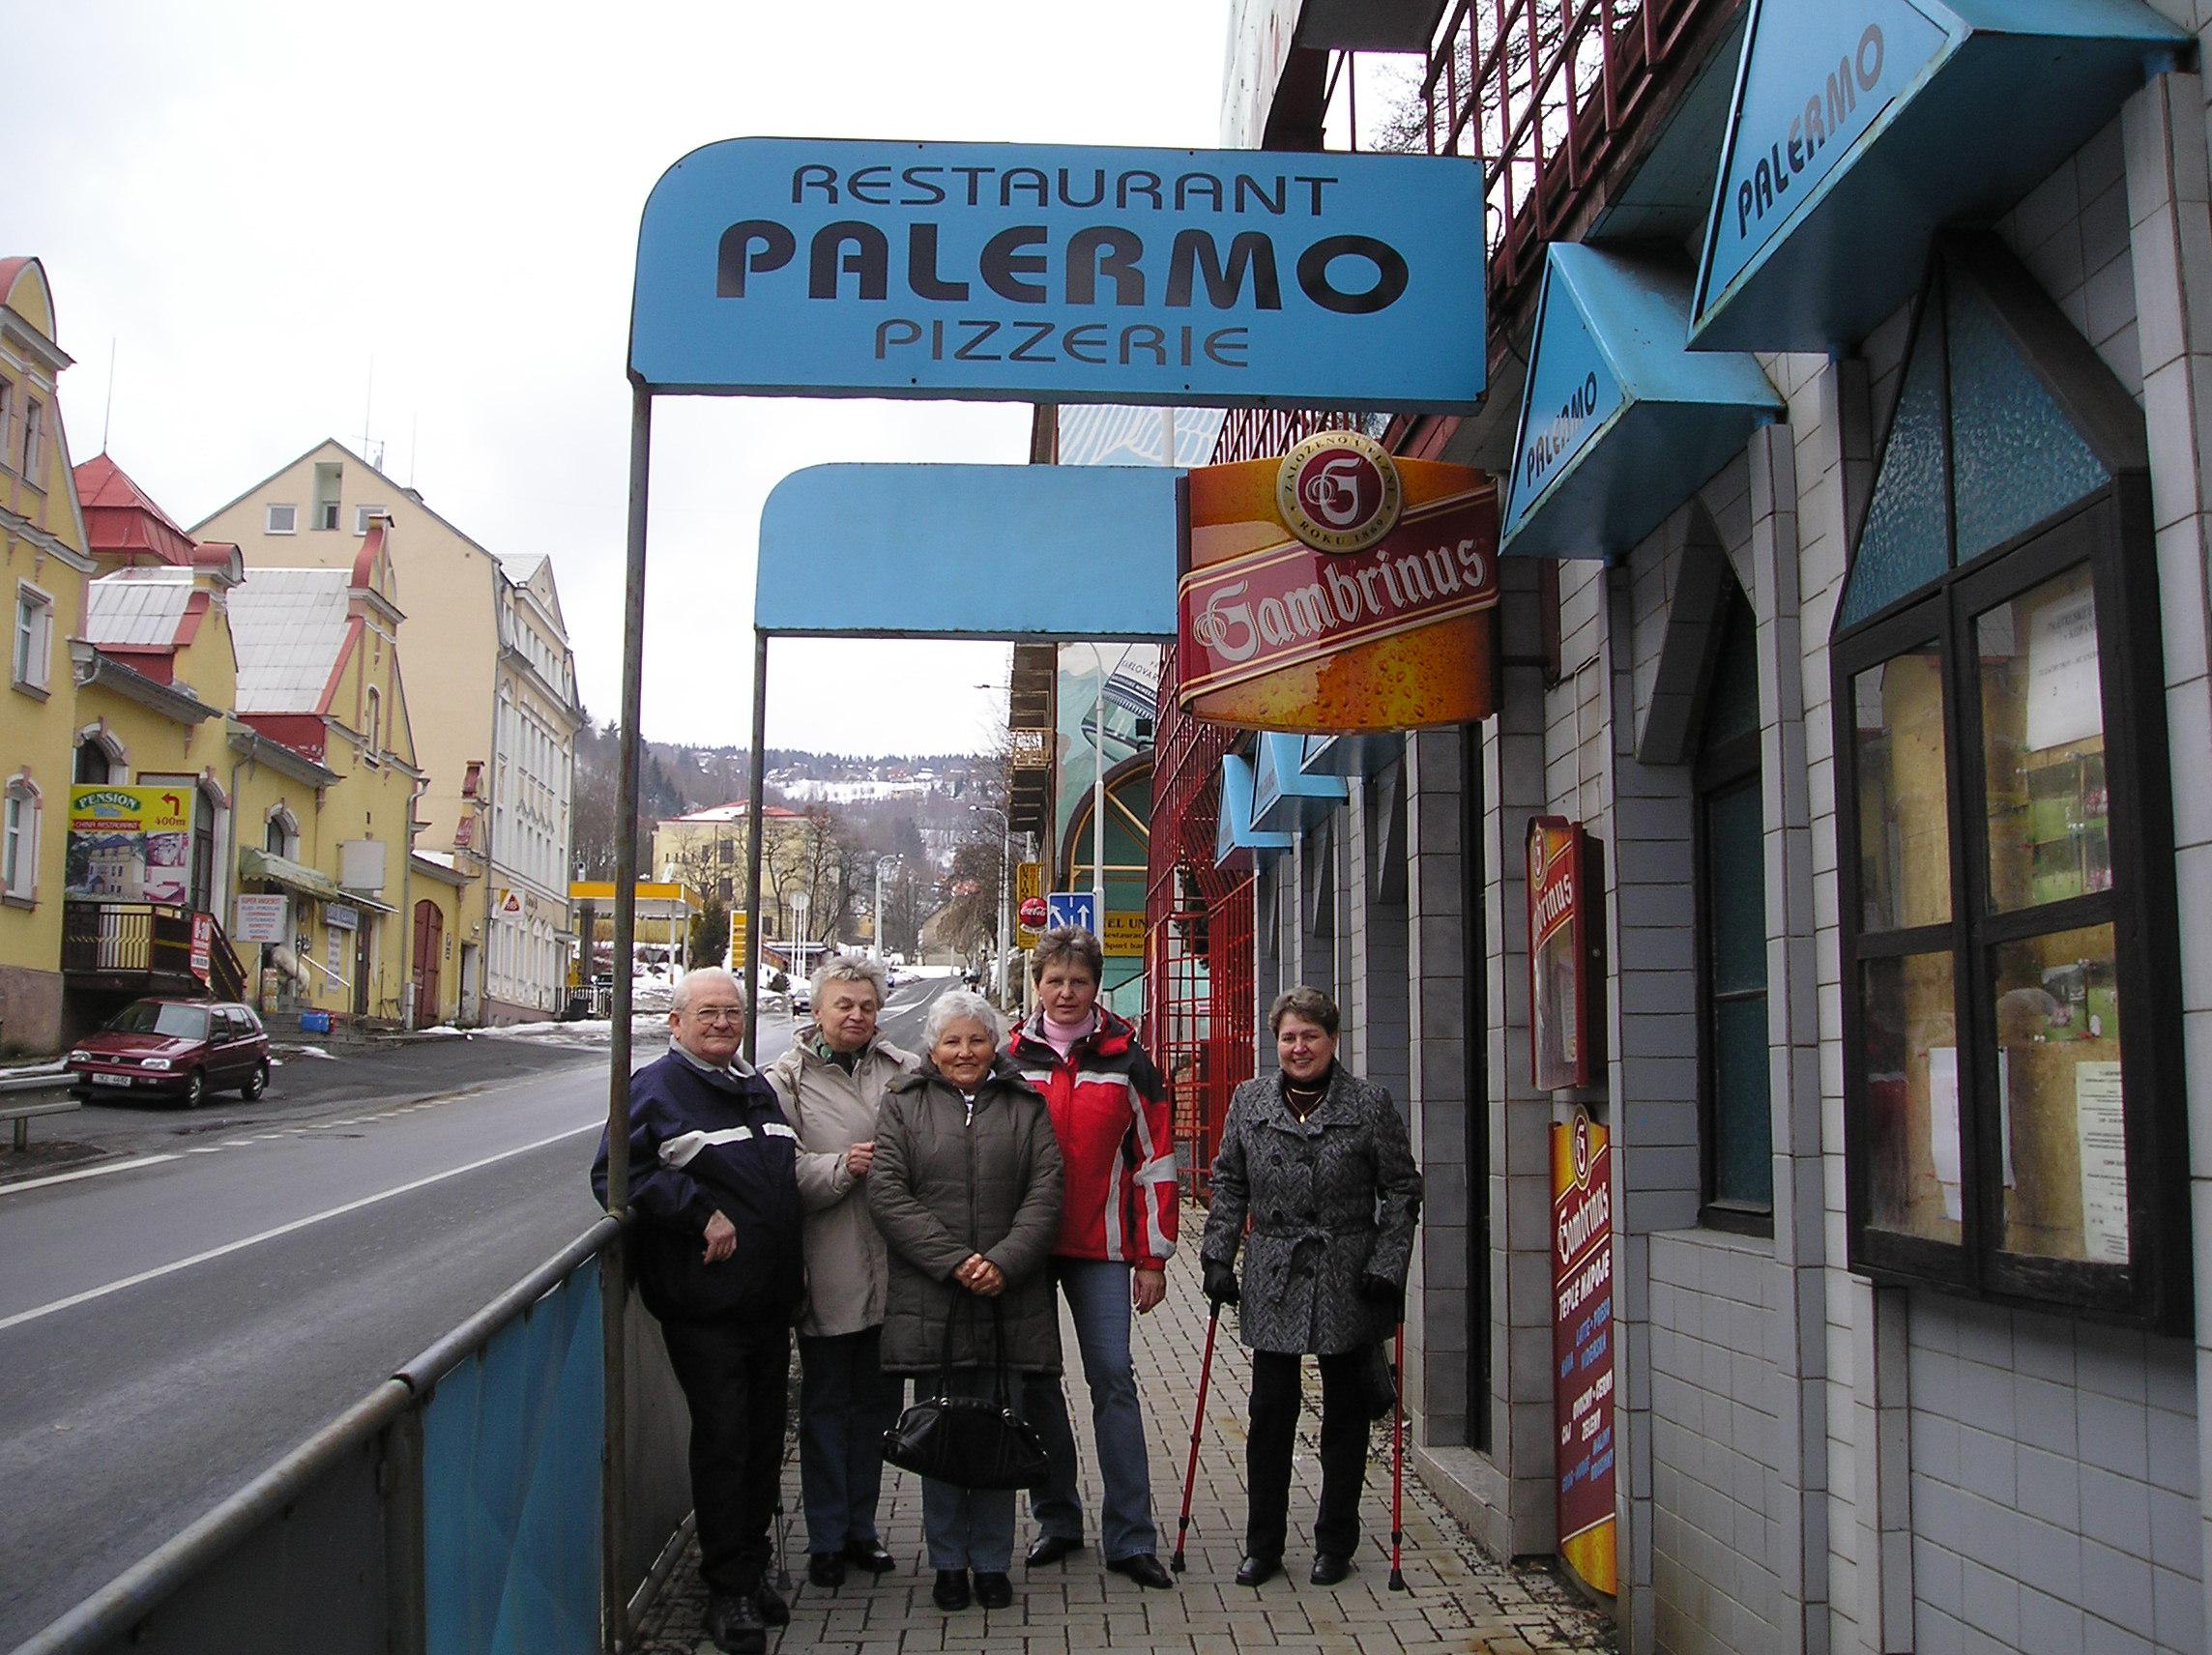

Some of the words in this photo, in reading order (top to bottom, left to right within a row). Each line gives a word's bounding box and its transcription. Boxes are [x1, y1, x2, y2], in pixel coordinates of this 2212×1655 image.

[1736, 23, 1885, 240] PALERMO
[791, 163, 1339, 217] RESTAURANT
[715, 218, 1410, 315] PALERMO
[873, 319, 1250, 368] PIZZERIE
[1527, 371, 1598, 488] PALERMO
[1299, 520, 1346, 545] ROKU
[1193, 537, 1487, 662] Gambrinus
[79, 793, 136, 809] PENSION
[1557, 1181, 1609, 1264] Gambrinus
